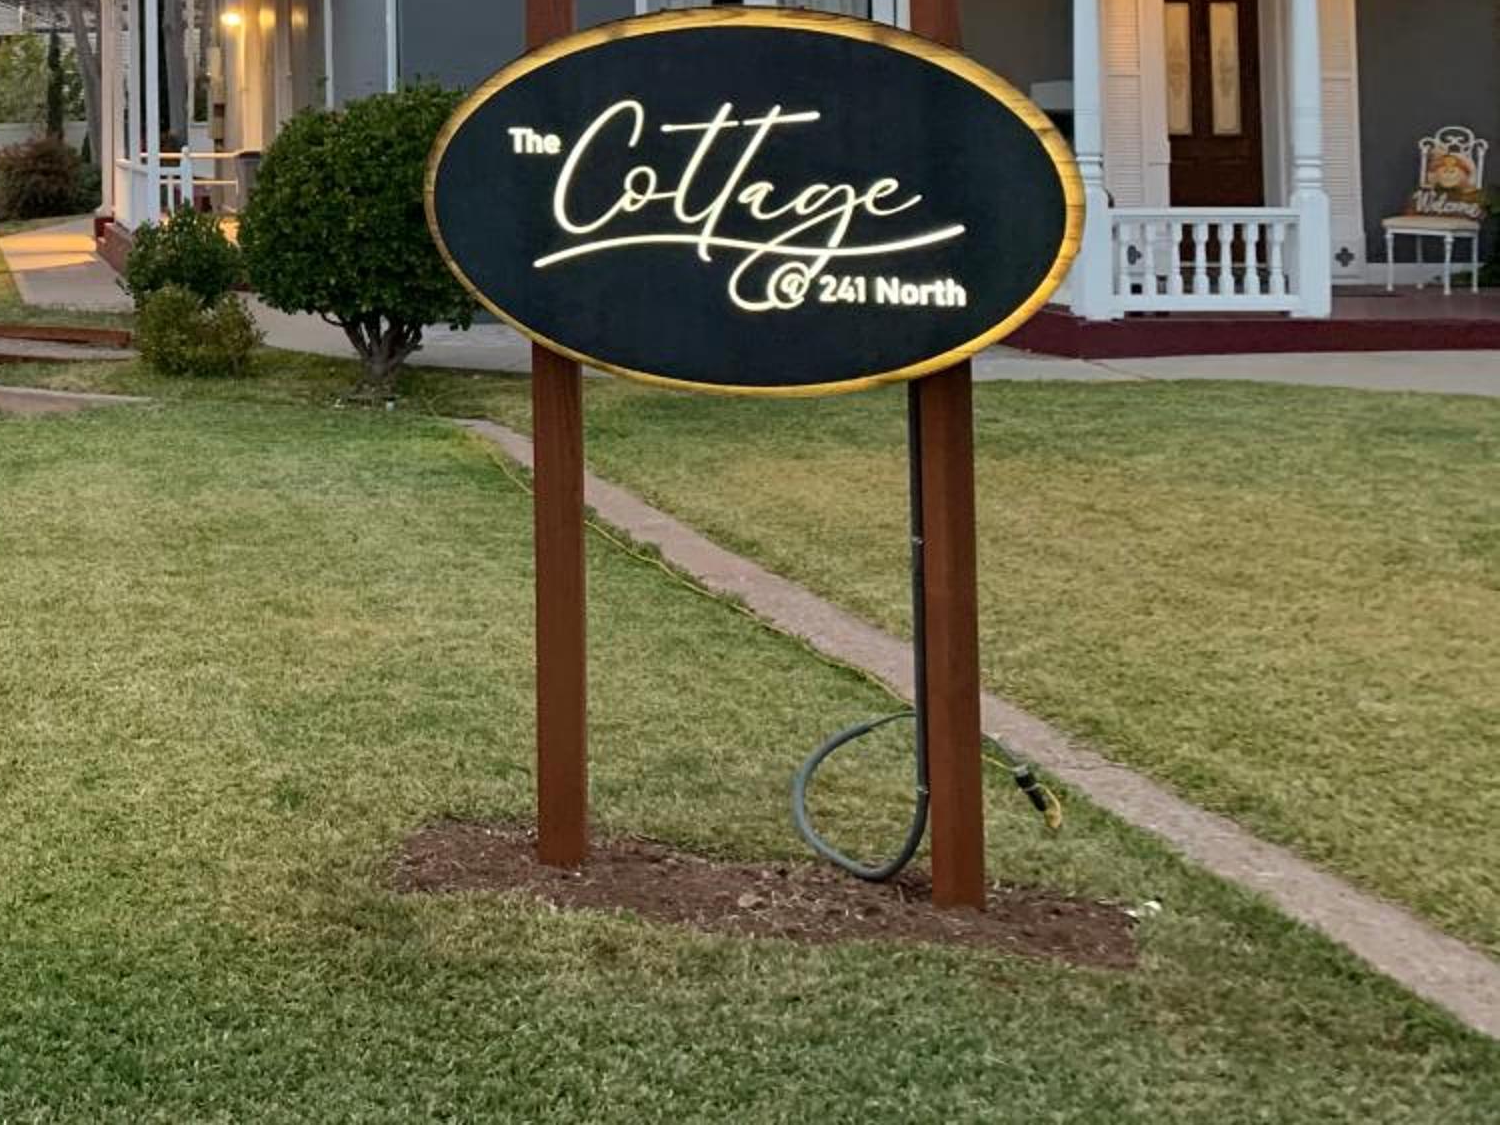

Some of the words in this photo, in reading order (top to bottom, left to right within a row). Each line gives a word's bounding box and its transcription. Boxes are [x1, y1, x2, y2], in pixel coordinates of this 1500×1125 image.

[508, 126, 562, 155] The
[553, 99, 923, 312] Cottage
[1411, 189, 1483, 218] Welcome
[766, 261, 812, 310] @
[818, 274, 867, 304] 241
[875, 277, 968, 308] North
